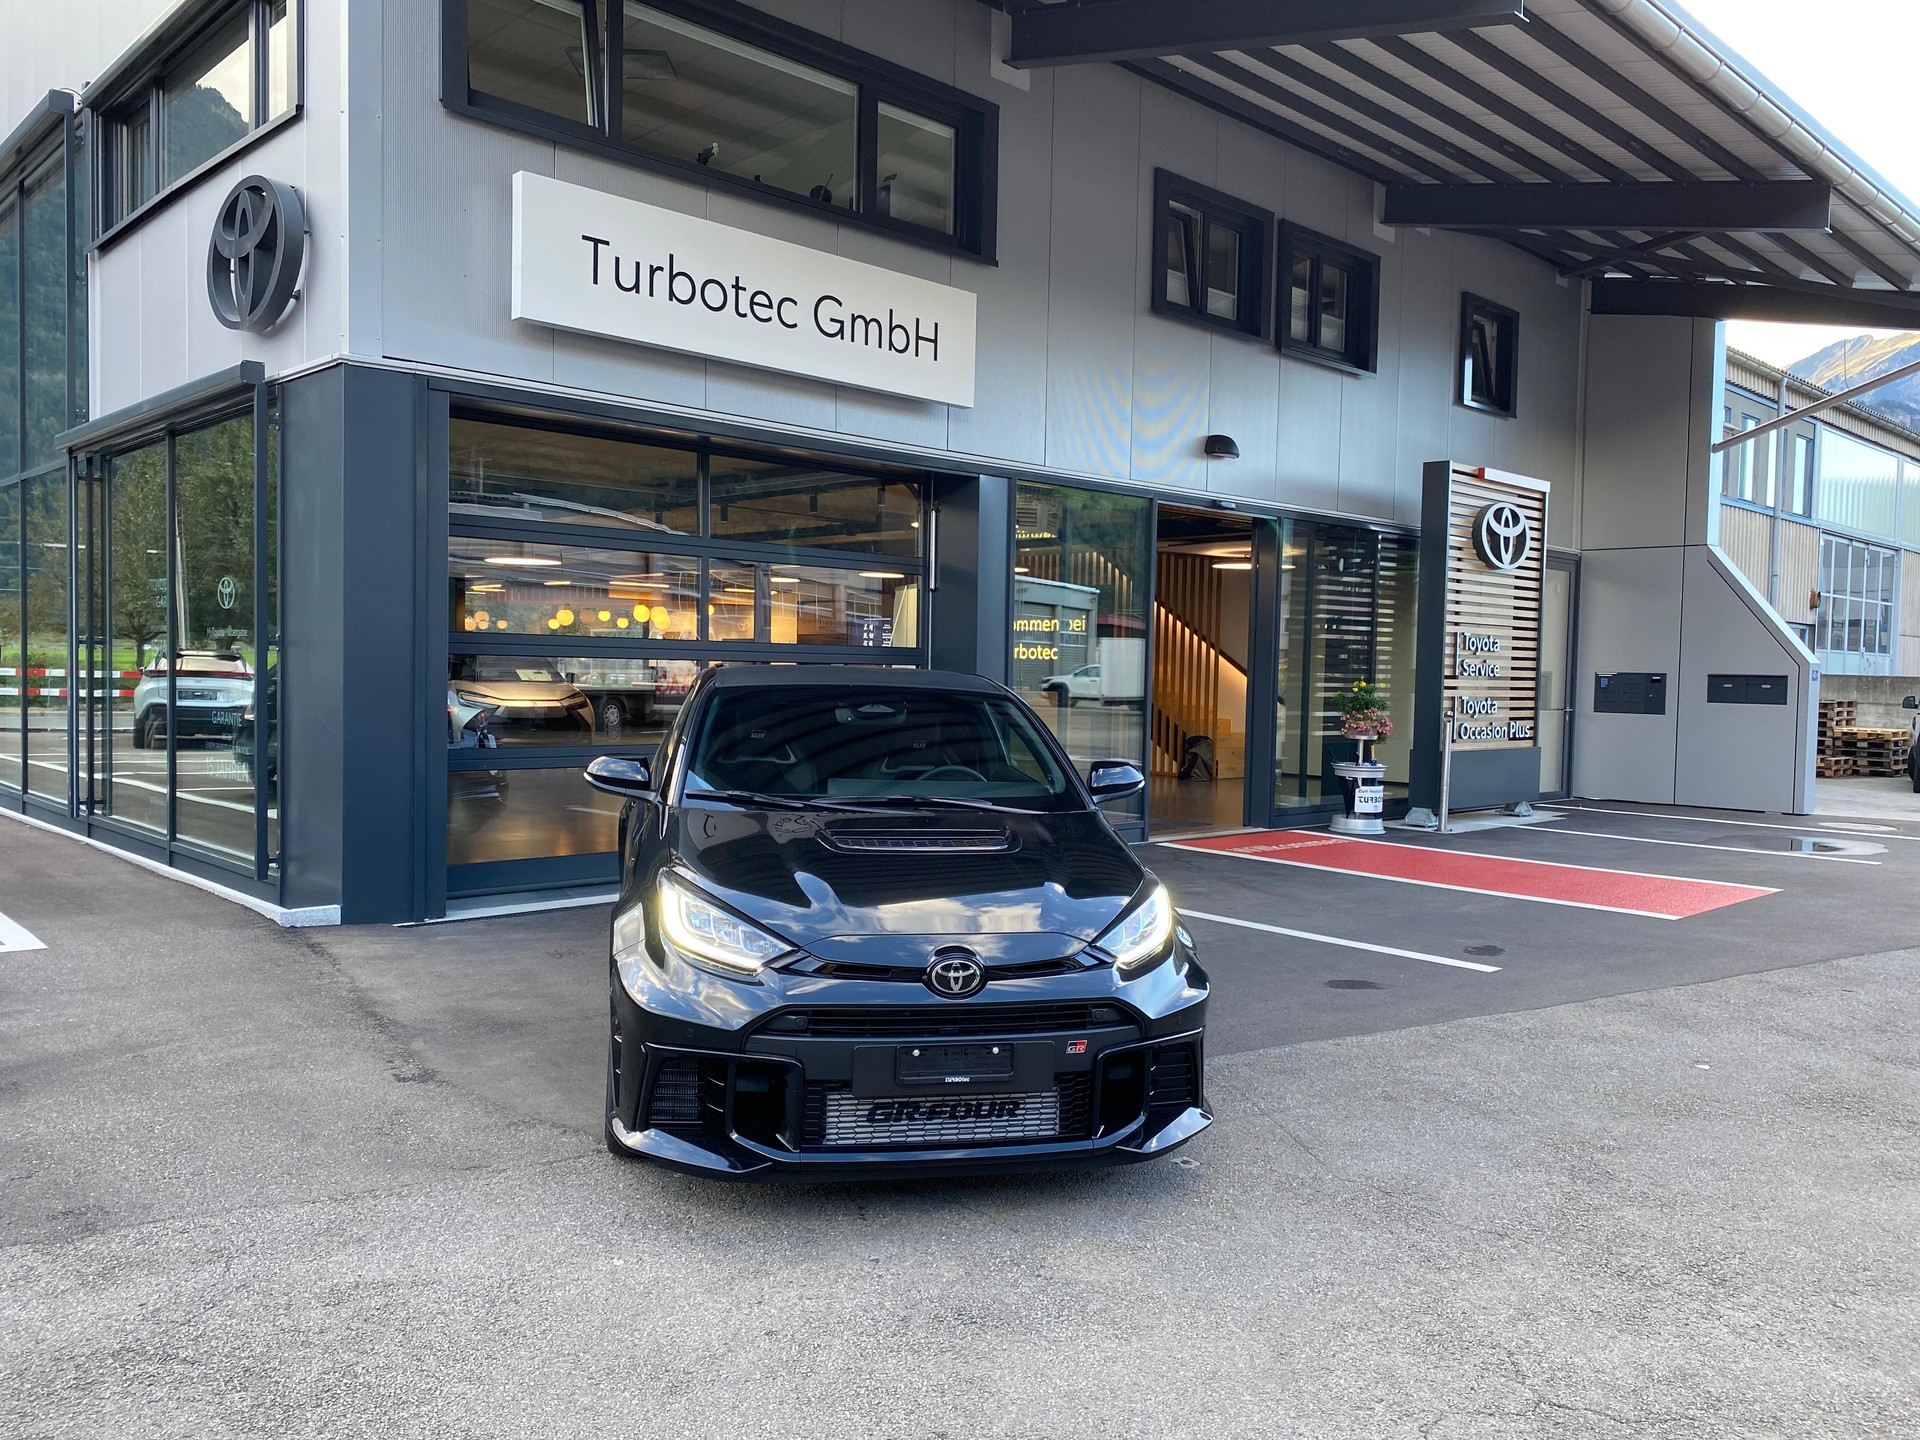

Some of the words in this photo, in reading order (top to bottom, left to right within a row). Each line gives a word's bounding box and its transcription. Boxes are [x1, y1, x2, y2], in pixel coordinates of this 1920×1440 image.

[581, 234, 798, 329] Turbotec
[813, 294, 939, 362] GmbH
[1463, 632, 1500, 656] Toyota
[1462, 659, 1500, 677] Service
[1461, 696, 1498, 719] Toyota
[211, 710, 242, 727] GARANTIE
[1460, 721, 1508, 740] Occasion
[1509, 720, 1530, 739] Plus
